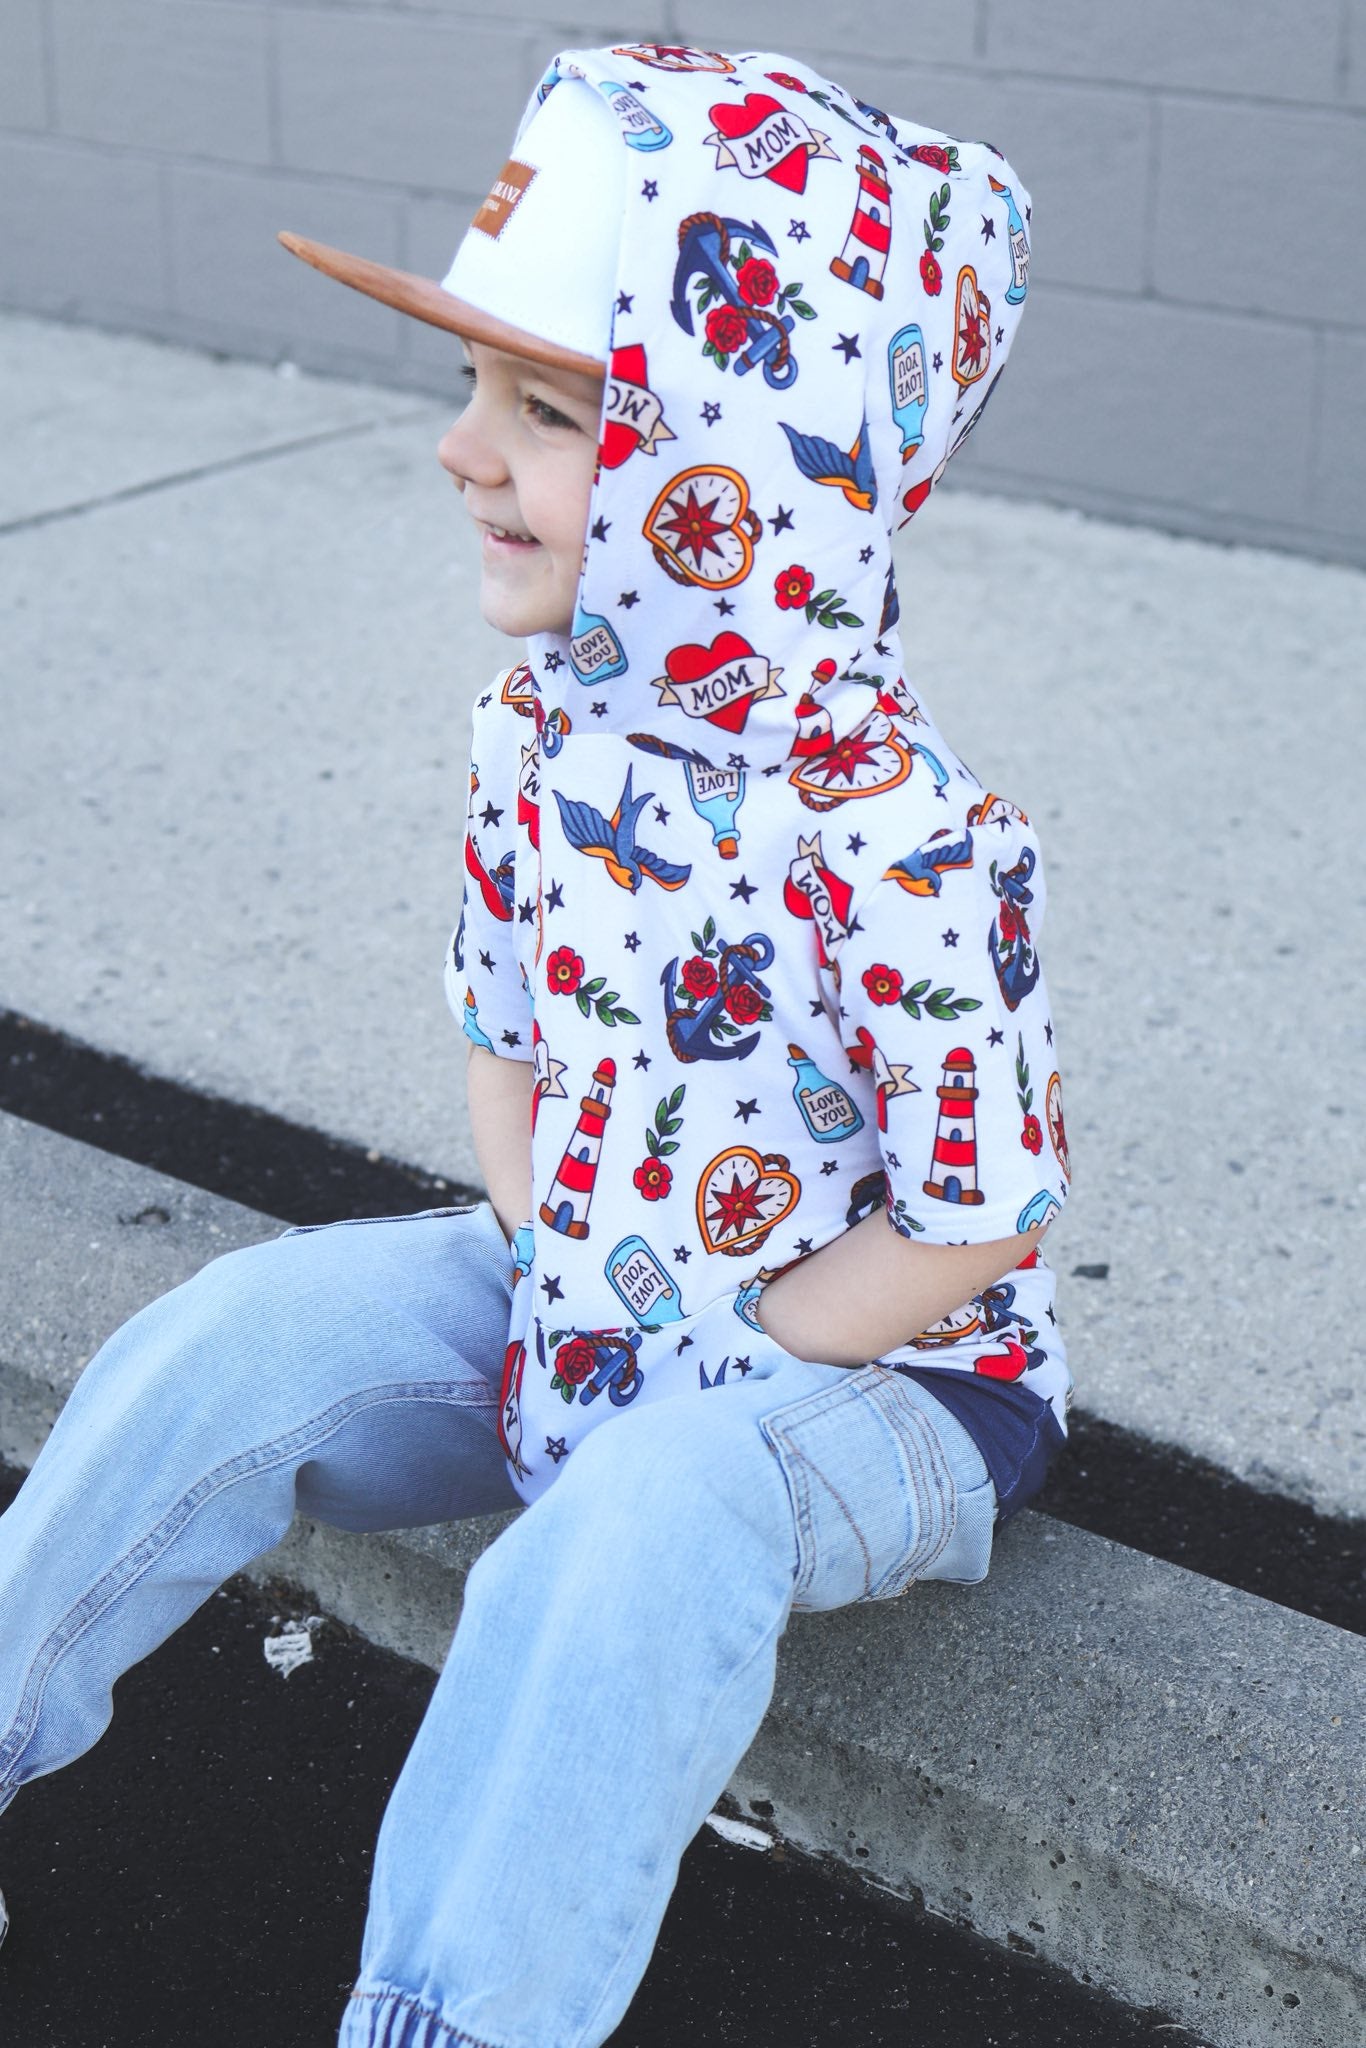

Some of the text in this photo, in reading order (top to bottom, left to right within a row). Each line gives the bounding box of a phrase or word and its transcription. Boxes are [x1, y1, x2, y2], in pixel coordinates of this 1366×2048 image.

[612, 95, 640, 113] OVE
[744, 116, 801, 169] MOM
[898, 352, 919, 379] YOU
[897, 371, 923, 402] LOVE
[606, 385, 651, 422] MO
[572, 630, 607, 657] LOVE
[582, 644, 612, 668] YOU
[690, 663, 755, 711] MOM
[697, 771, 735, 795] LOVE
[807, 1090, 844, 1113] LOVE
[817, 1104, 848, 1127] YOU
[622, 1259, 649, 1291] YOU
[631, 1271, 663, 1310] LOVE
